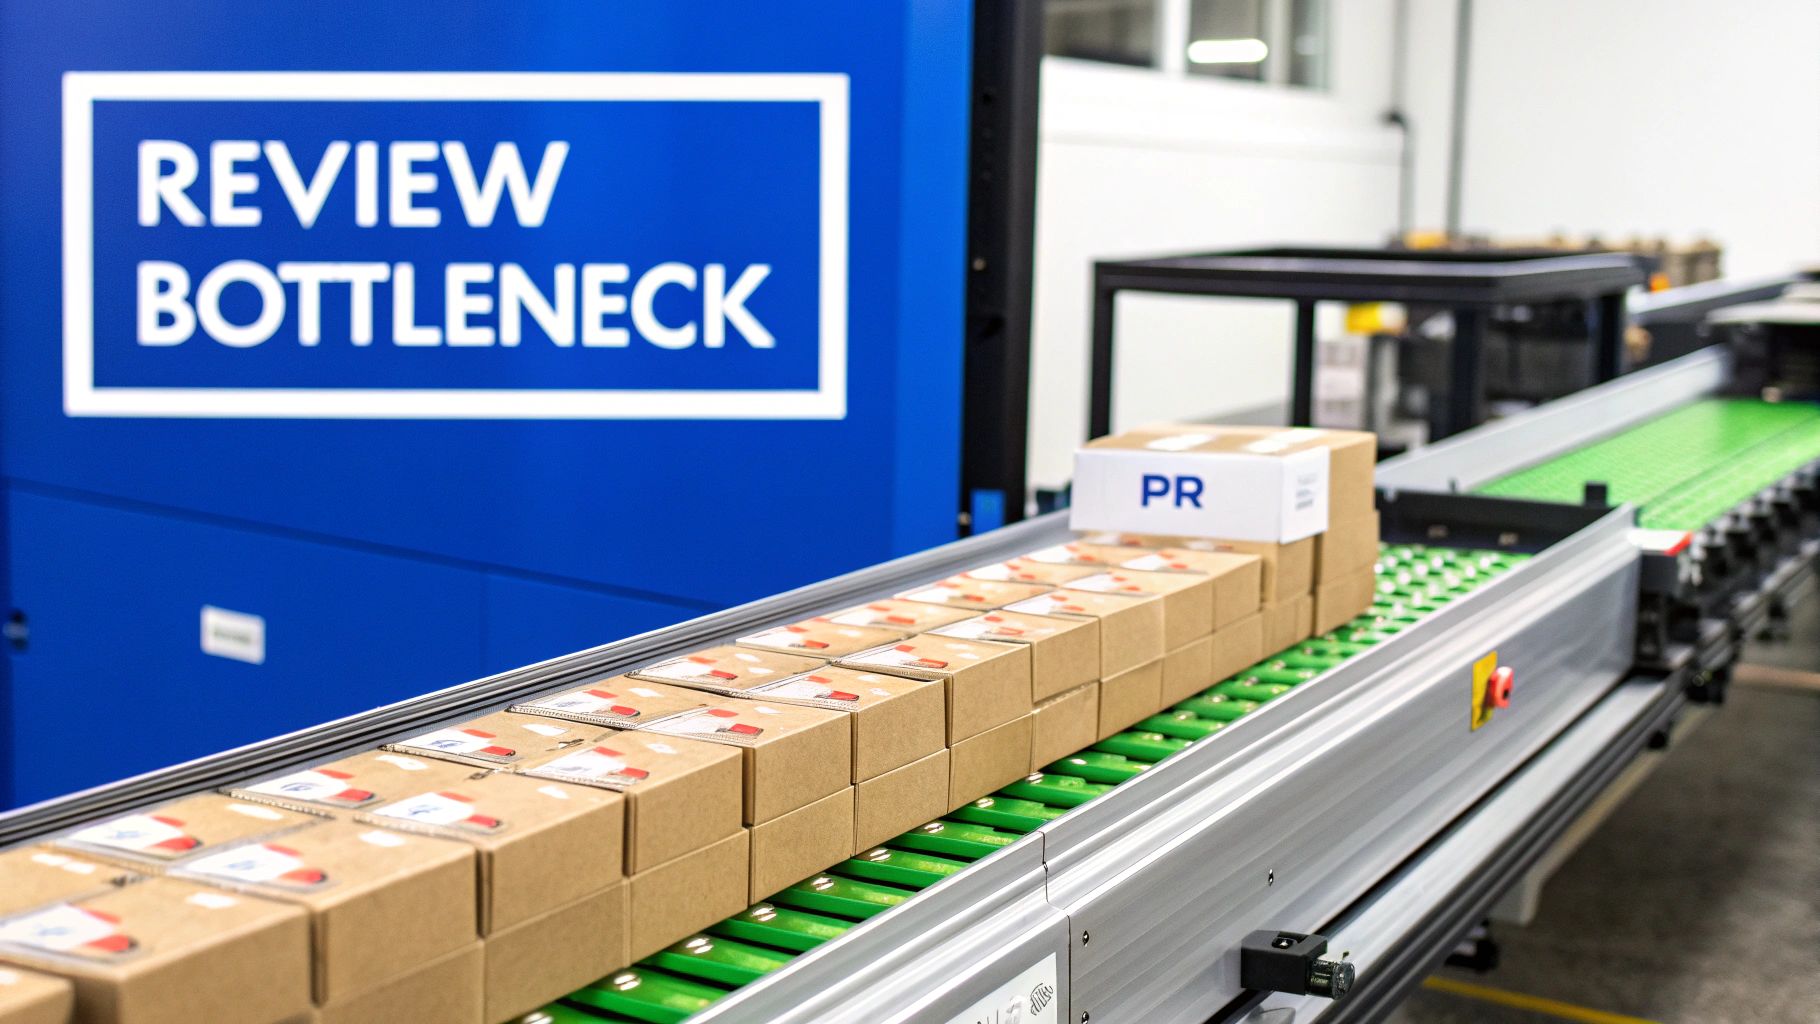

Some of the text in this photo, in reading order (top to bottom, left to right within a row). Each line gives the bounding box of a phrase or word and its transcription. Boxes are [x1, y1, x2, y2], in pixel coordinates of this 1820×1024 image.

[137, 139, 569, 228] REVIEW
[136, 260, 775, 349] BOTTLENECK
[1141, 473, 1204, 509] PR
